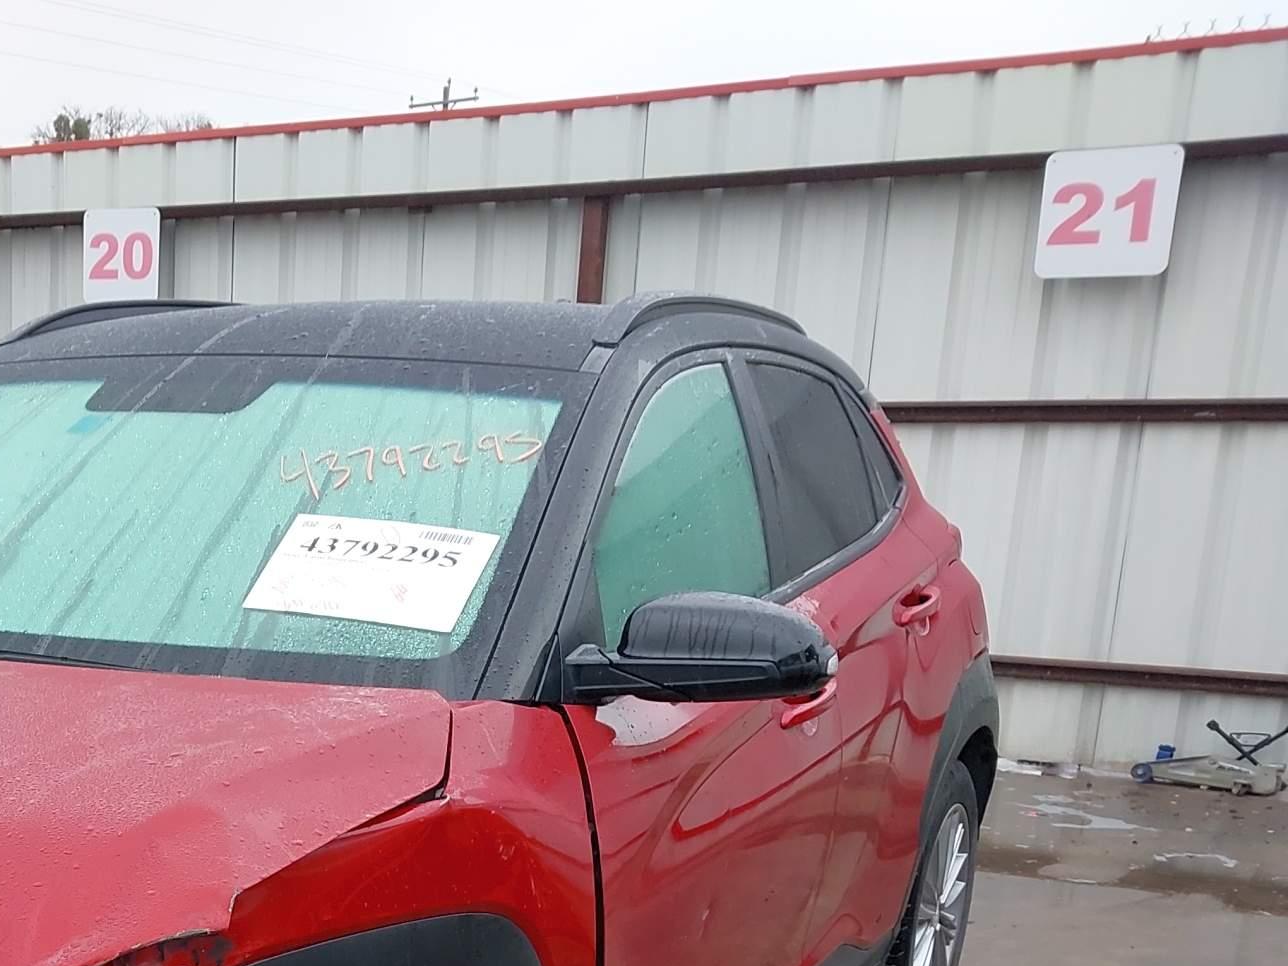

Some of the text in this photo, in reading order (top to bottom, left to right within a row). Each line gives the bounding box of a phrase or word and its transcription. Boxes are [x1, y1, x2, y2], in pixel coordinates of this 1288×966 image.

[1046, 178, 1157, 246] 21
[88, 232, 153, 280] 20
[280, 432, 543, 500] 43792295
[300, 536, 462, 568] 43792295
